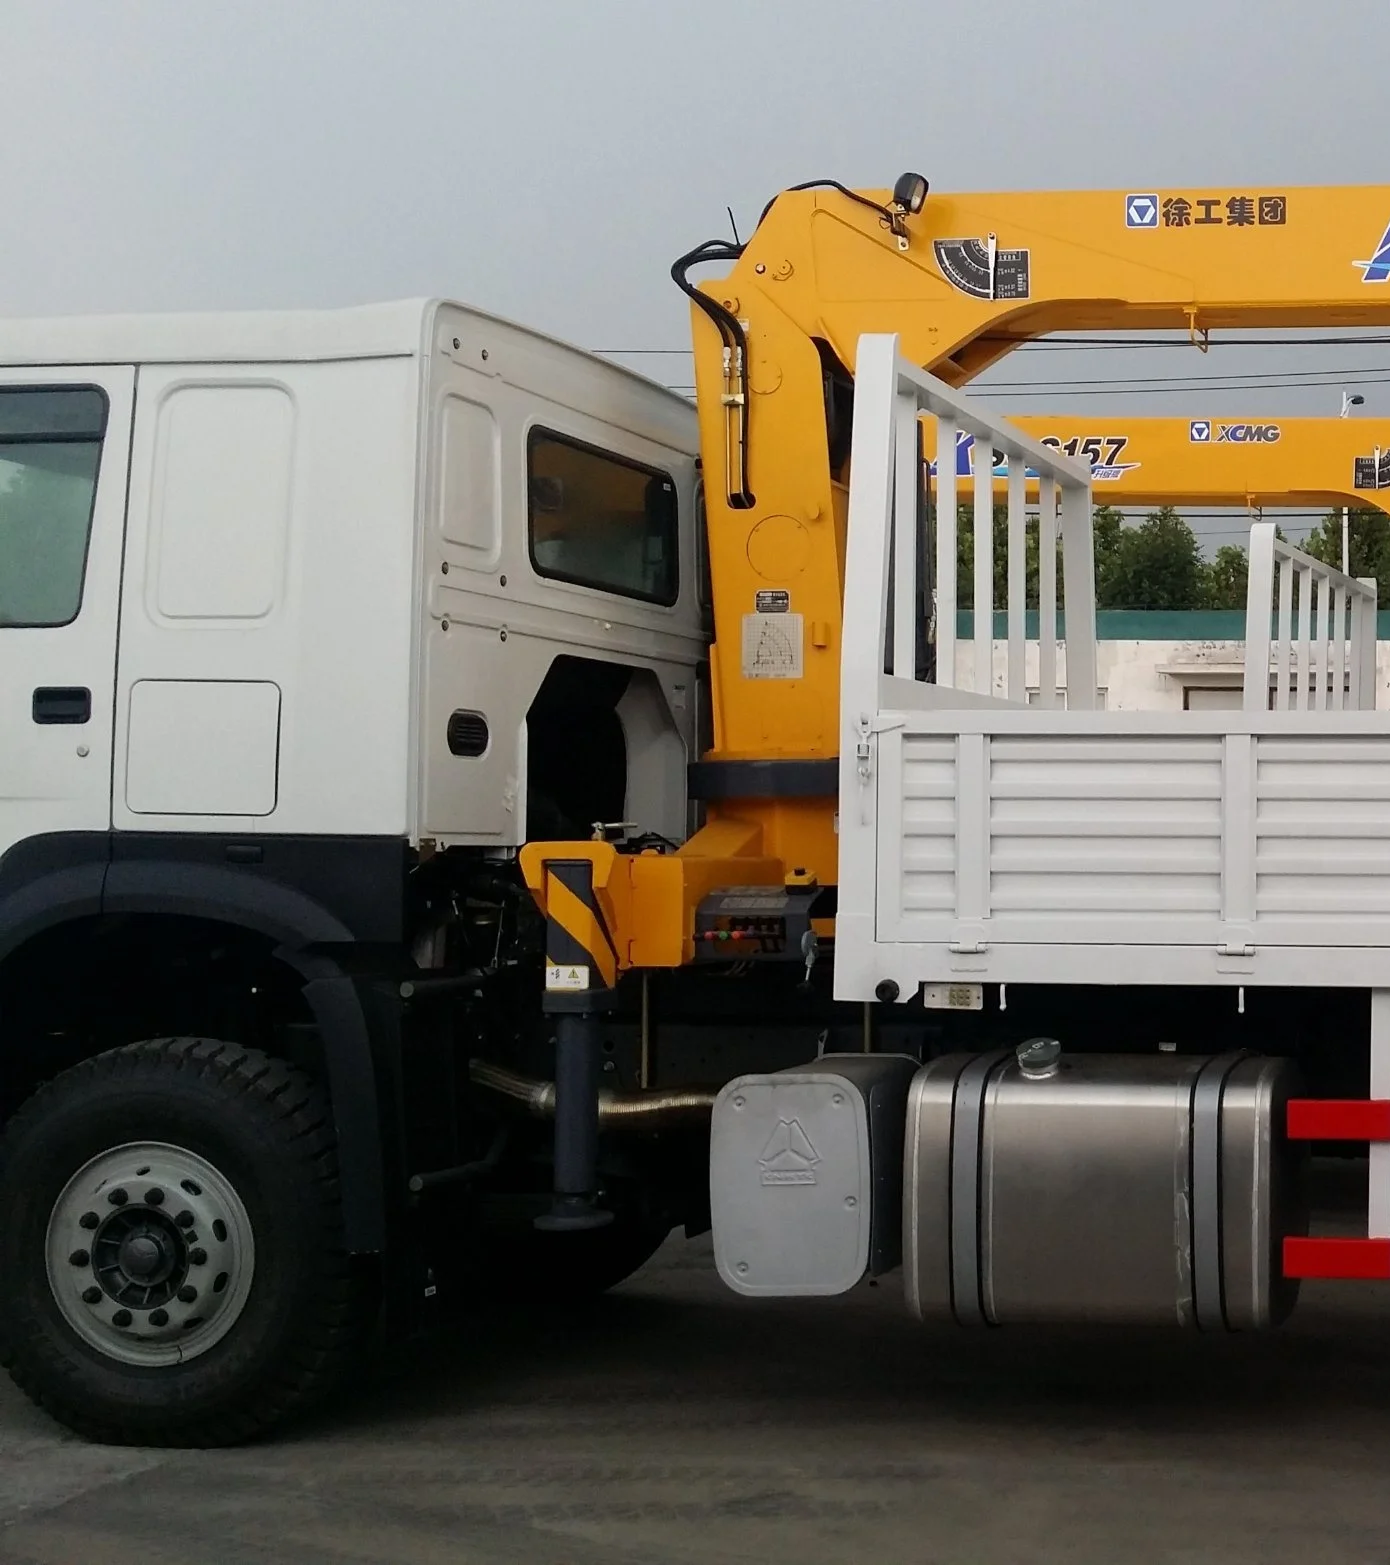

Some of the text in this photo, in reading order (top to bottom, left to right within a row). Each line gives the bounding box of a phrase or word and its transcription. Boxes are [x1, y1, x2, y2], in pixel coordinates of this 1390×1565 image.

[1162, 196, 1287, 227] 徐工集团
[1216, 424, 1281, 442] XCMG
